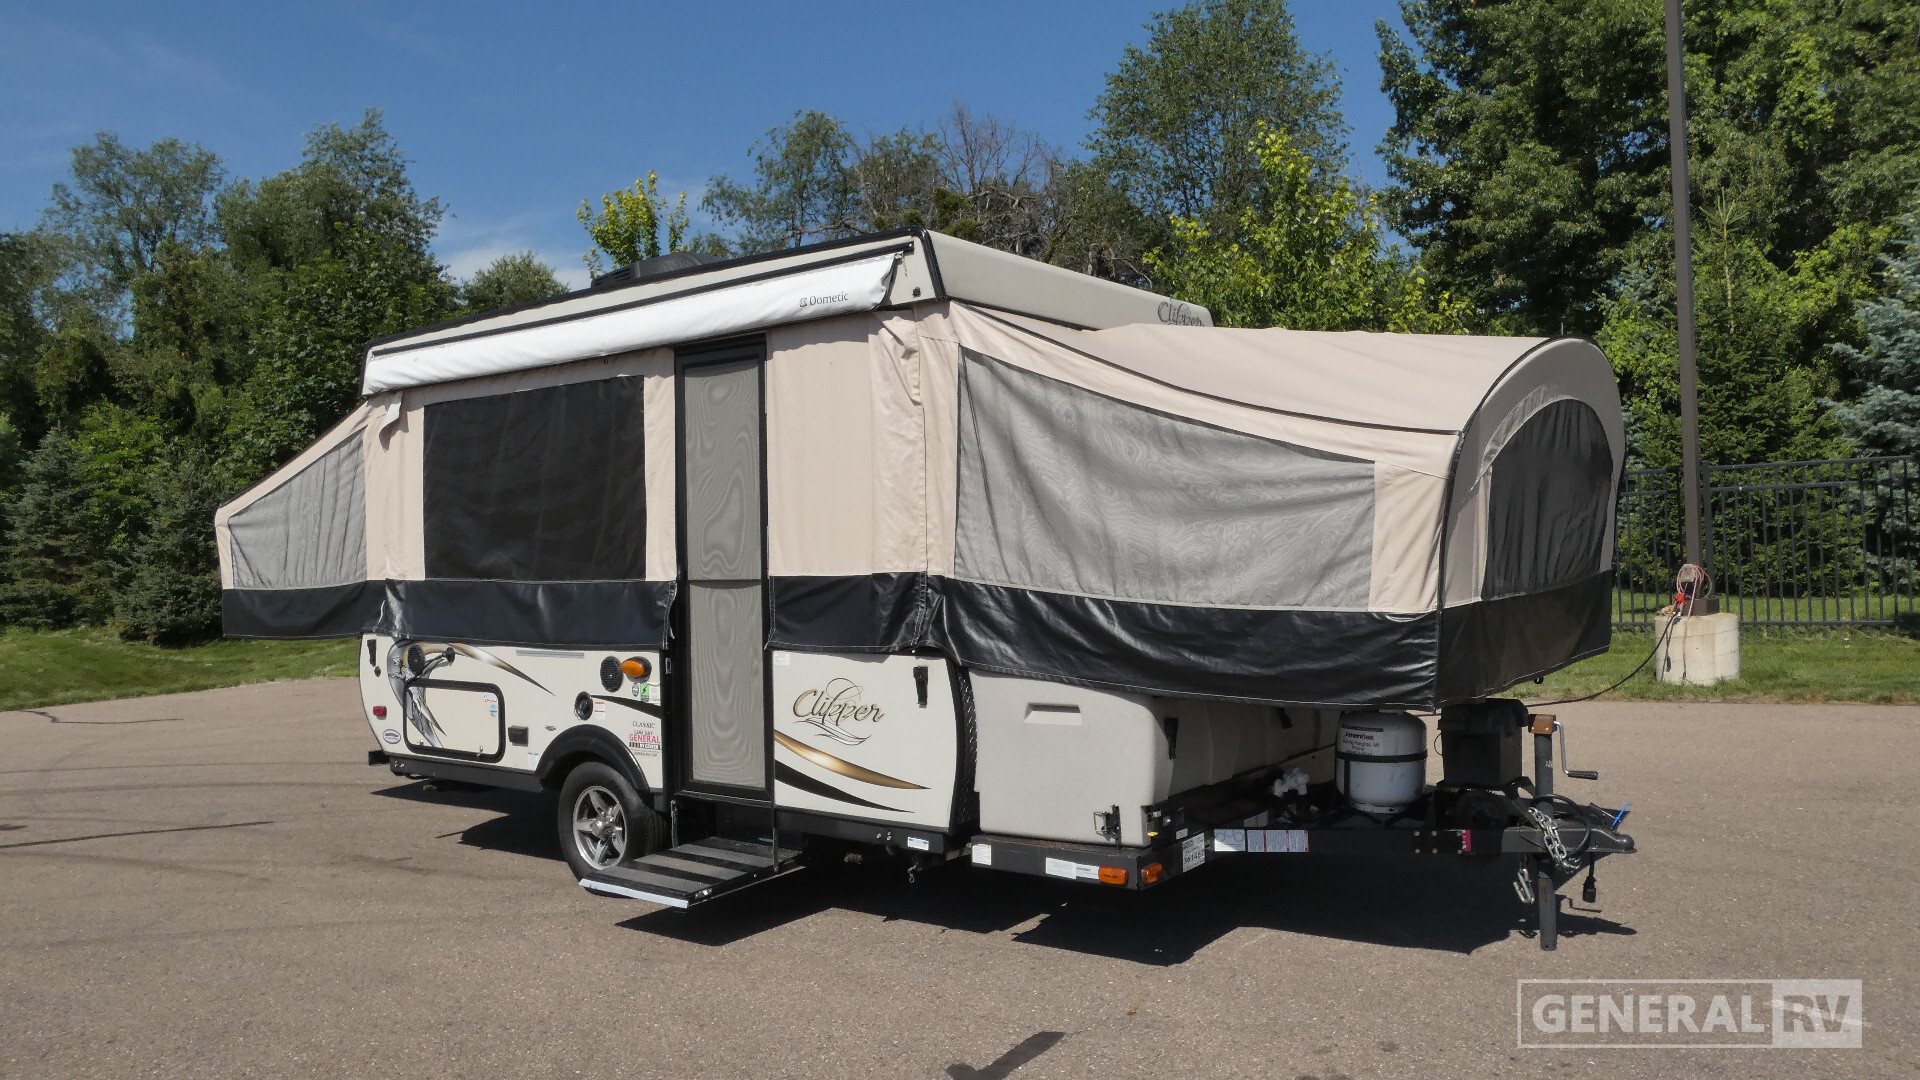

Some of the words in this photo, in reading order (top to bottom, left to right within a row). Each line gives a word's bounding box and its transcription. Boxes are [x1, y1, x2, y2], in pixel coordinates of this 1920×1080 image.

[809, 291, 849, 306] Dometic
[792, 677, 885, 727] Clipper
[629, 733, 660, 743] GENERAL
